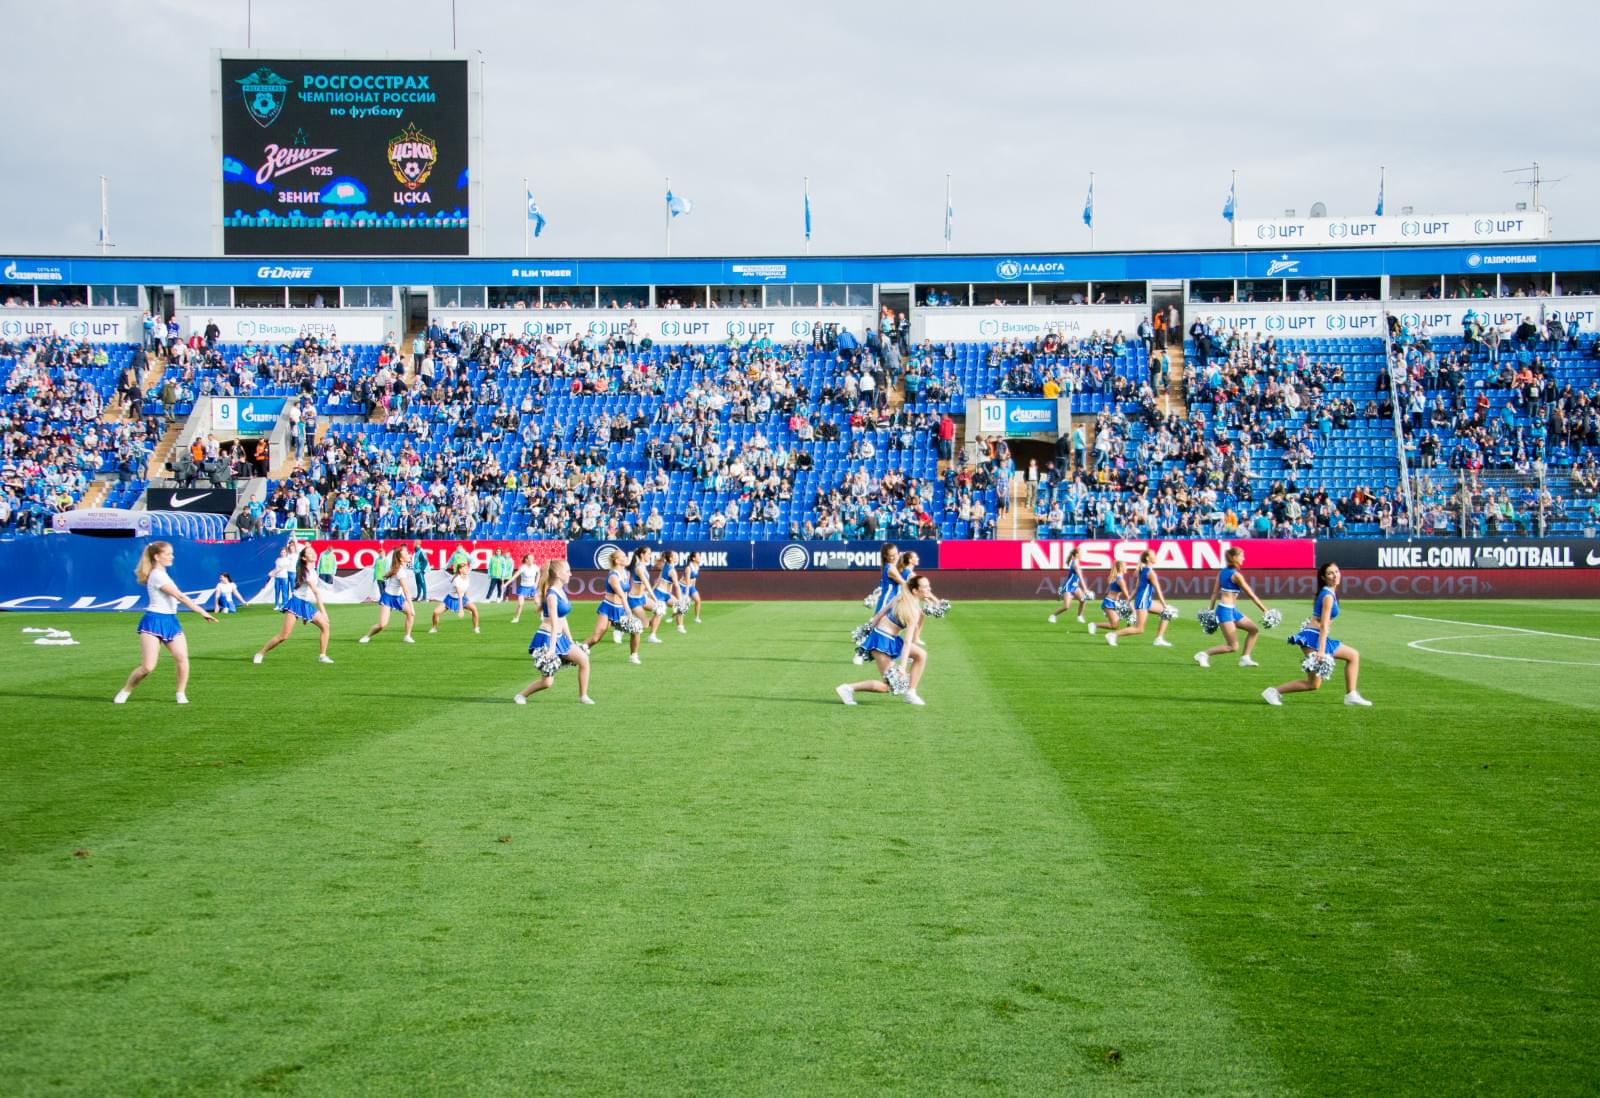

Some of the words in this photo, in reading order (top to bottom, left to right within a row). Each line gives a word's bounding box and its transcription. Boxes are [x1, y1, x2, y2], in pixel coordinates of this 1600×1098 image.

[303, 75, 430, 89] РОСГОССТРАХ
[298, 92, 379, 102] ЧЕМПИОНАТ
[383, 92, 436, 102] РОССИИ
[349, 105, 403, 118] футболу
[392, 142, 433, 161] ЦСКА
[310, 167, 333, 175] 1925
[278, 192, 320, 203] ЗЕНИТ
[394, 192, 431, 205] ЦСКА
[1279, 225, 1304, 237] ЦРТ
[1351, 224, 1376, 235] ЦРТ
[1423, 222, 1449, 233] ЦРТ
[1497, 220, 1523, 232] ЦРТ
[1229, 318, 1256, 329] ЦРТ
[1288, 317, 1315, 329] ЦРТ
[1350, 316, 1376, 328] ЦРТ
[1424, 315, 1451, 327] ЦРТ
[26, 323, 52, 334] ЦРТ
[93, 323, 119, 335] ЦРТ
[260, 323, 297, 336] Визирь
[301, 323, 336, 333] АРЕНА
[481, 323, 508, 334] ЦРТ
[546, 323, 572, 334] ЦРТ
[684, 323, 709, 334] ЦРТ
[749, 323, 774, 334] ЦРТ
[1002, 322, 1039, 335] Визирь
[1043, 320, 1080, 331] АРЕНА
[221, 404, 229, 418] 9
[985, 405, 1000, 420] 10
[1021, 542, 1231, 569] NISSAN
